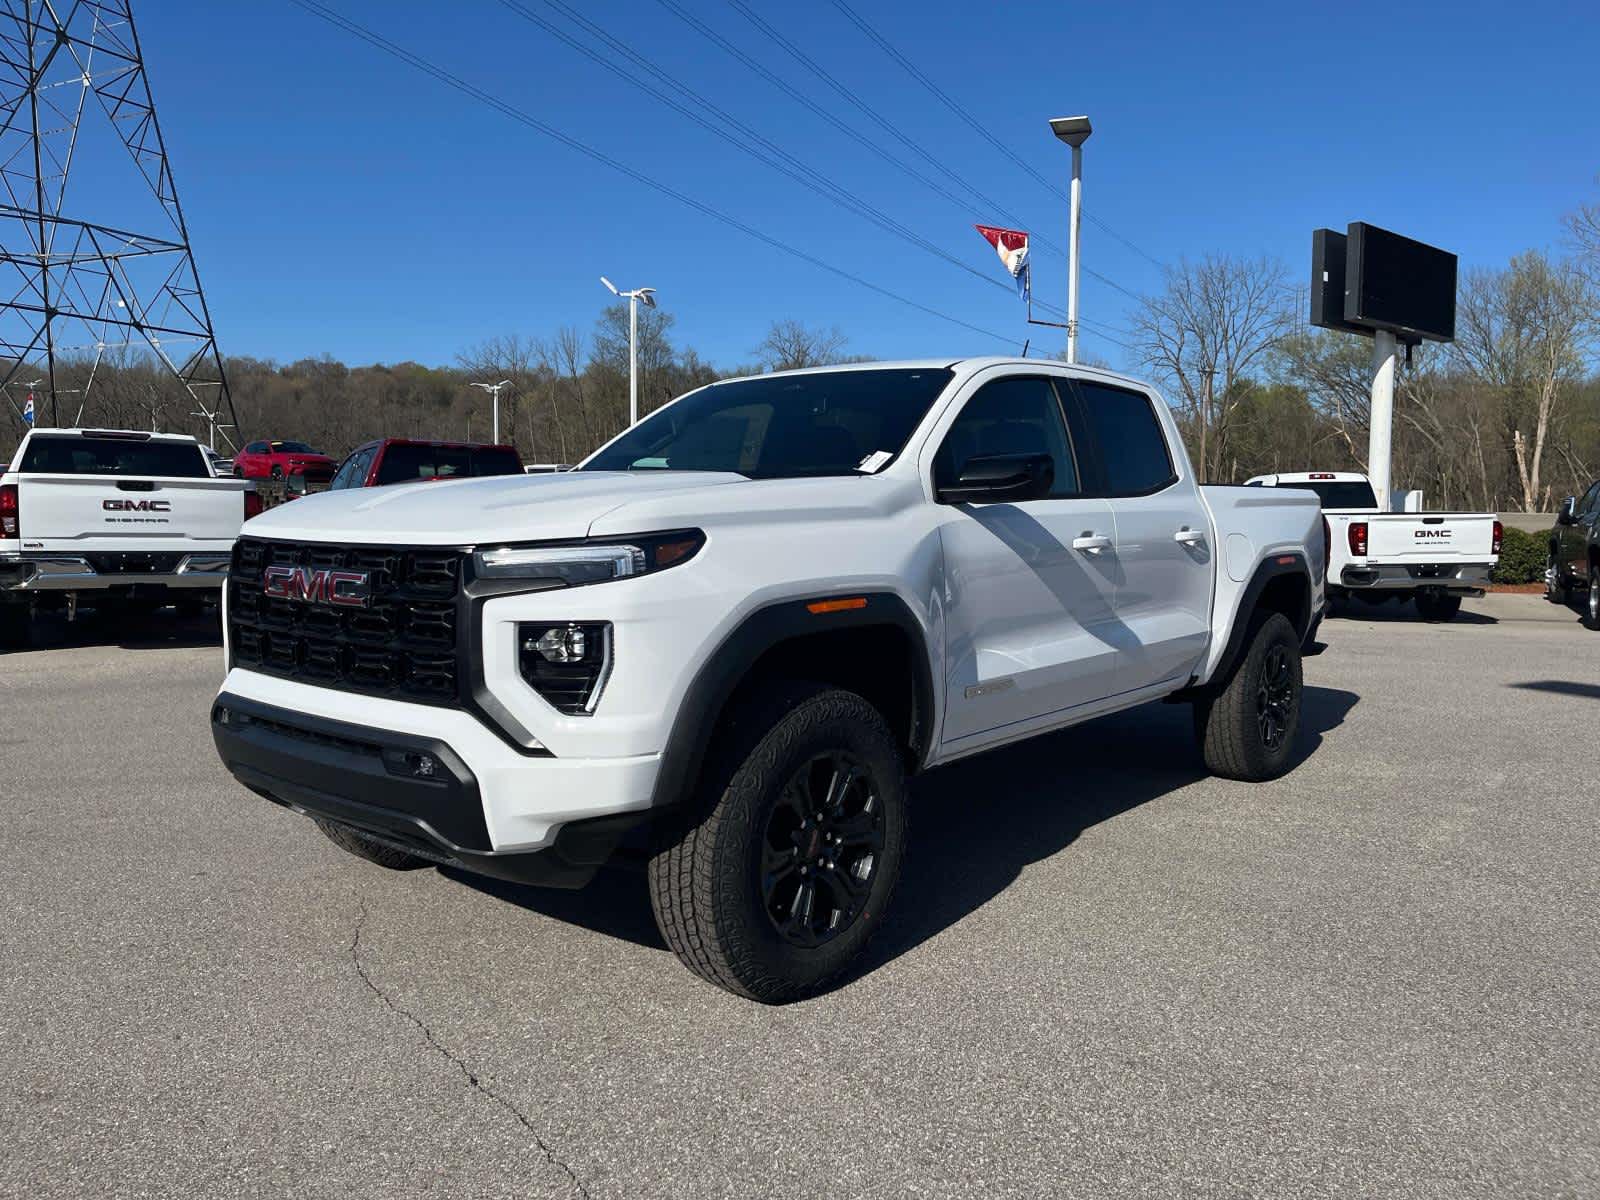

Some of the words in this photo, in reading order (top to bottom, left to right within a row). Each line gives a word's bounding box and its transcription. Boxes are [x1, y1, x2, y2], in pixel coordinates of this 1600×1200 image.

[103, 499, 170, 512] GMC
[1414, 530, 1451, 538] GMC
[264, 566, 368, 608] GMC
